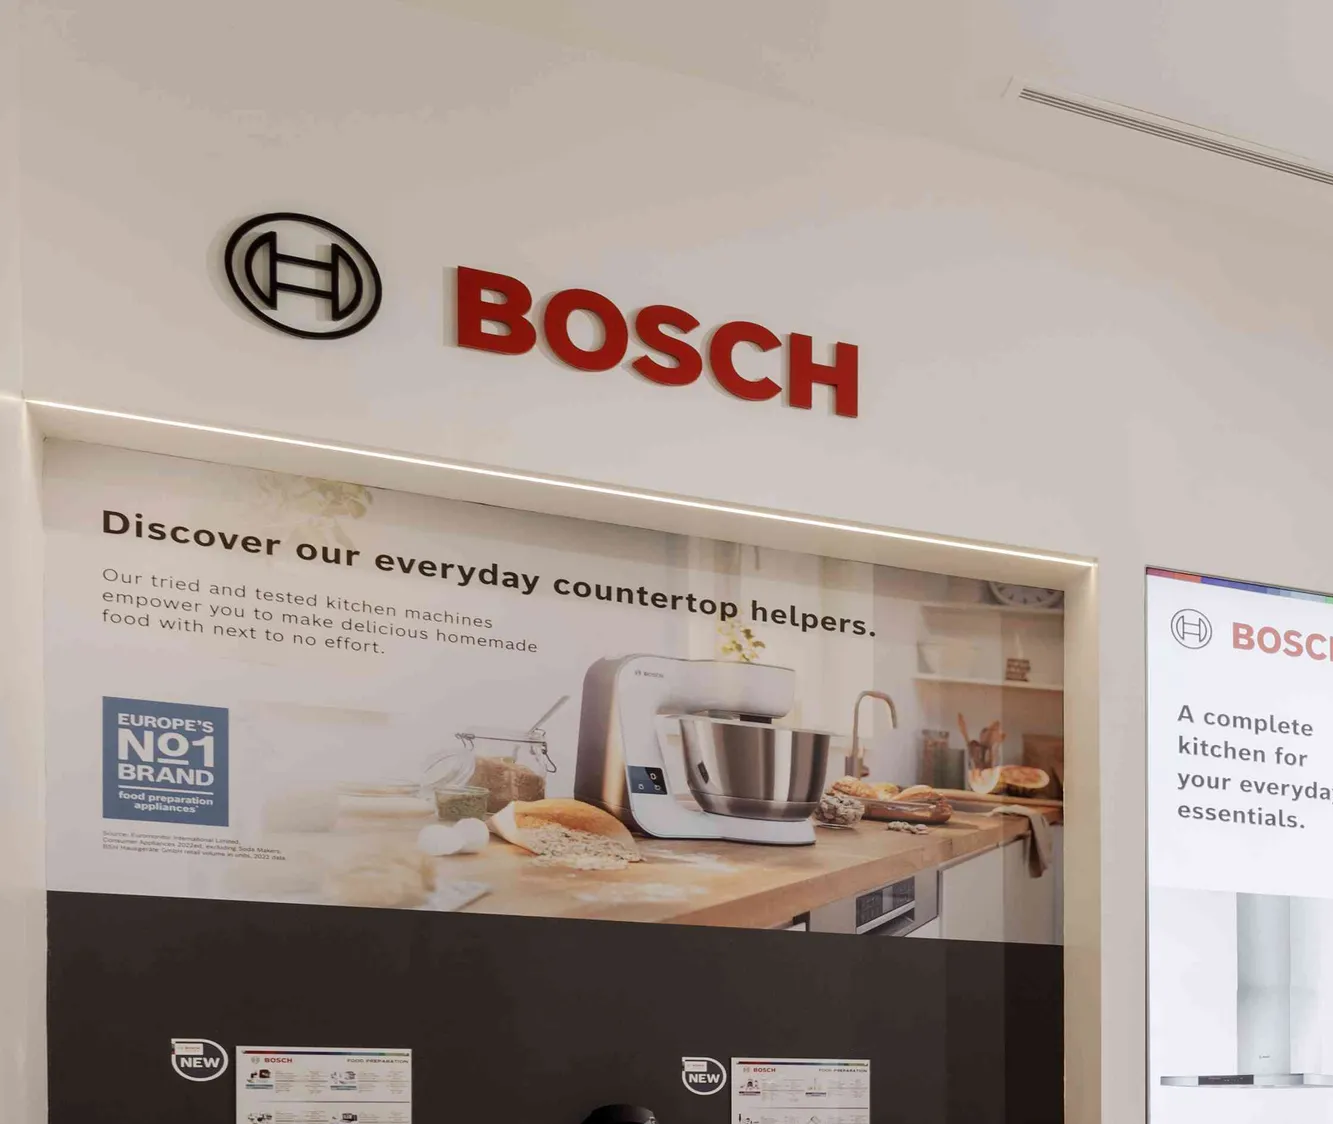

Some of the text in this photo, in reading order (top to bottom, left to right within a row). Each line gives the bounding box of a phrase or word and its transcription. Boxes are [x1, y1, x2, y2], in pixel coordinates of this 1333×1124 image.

[457, 265, 859, 419] BOSCH
[102, 509, 877, 638] Discover our everyday countertop helpers.
[102, 567, 494, 629] Our tried and tested kitchen machines
[102, 590, 539, 654] empower you to make delicious homemade
[102, 608, 386, 656] food with next to no effort.
[117, 712, 215, 733] EUROPE'S
[1177, 704, 1314, 737] A complete
[1178, 735, 1308, 767] kitchen for
[117, 763, 215, 786] BRAND
[1177, 772, 1232, 791] your
[118, 790, 214, 806] food preparation
[1177, 804, 1306, 829] essentials.
[180, 1057, 220, 1068] NEW
[689, 1073, 720, 1084] NEW
